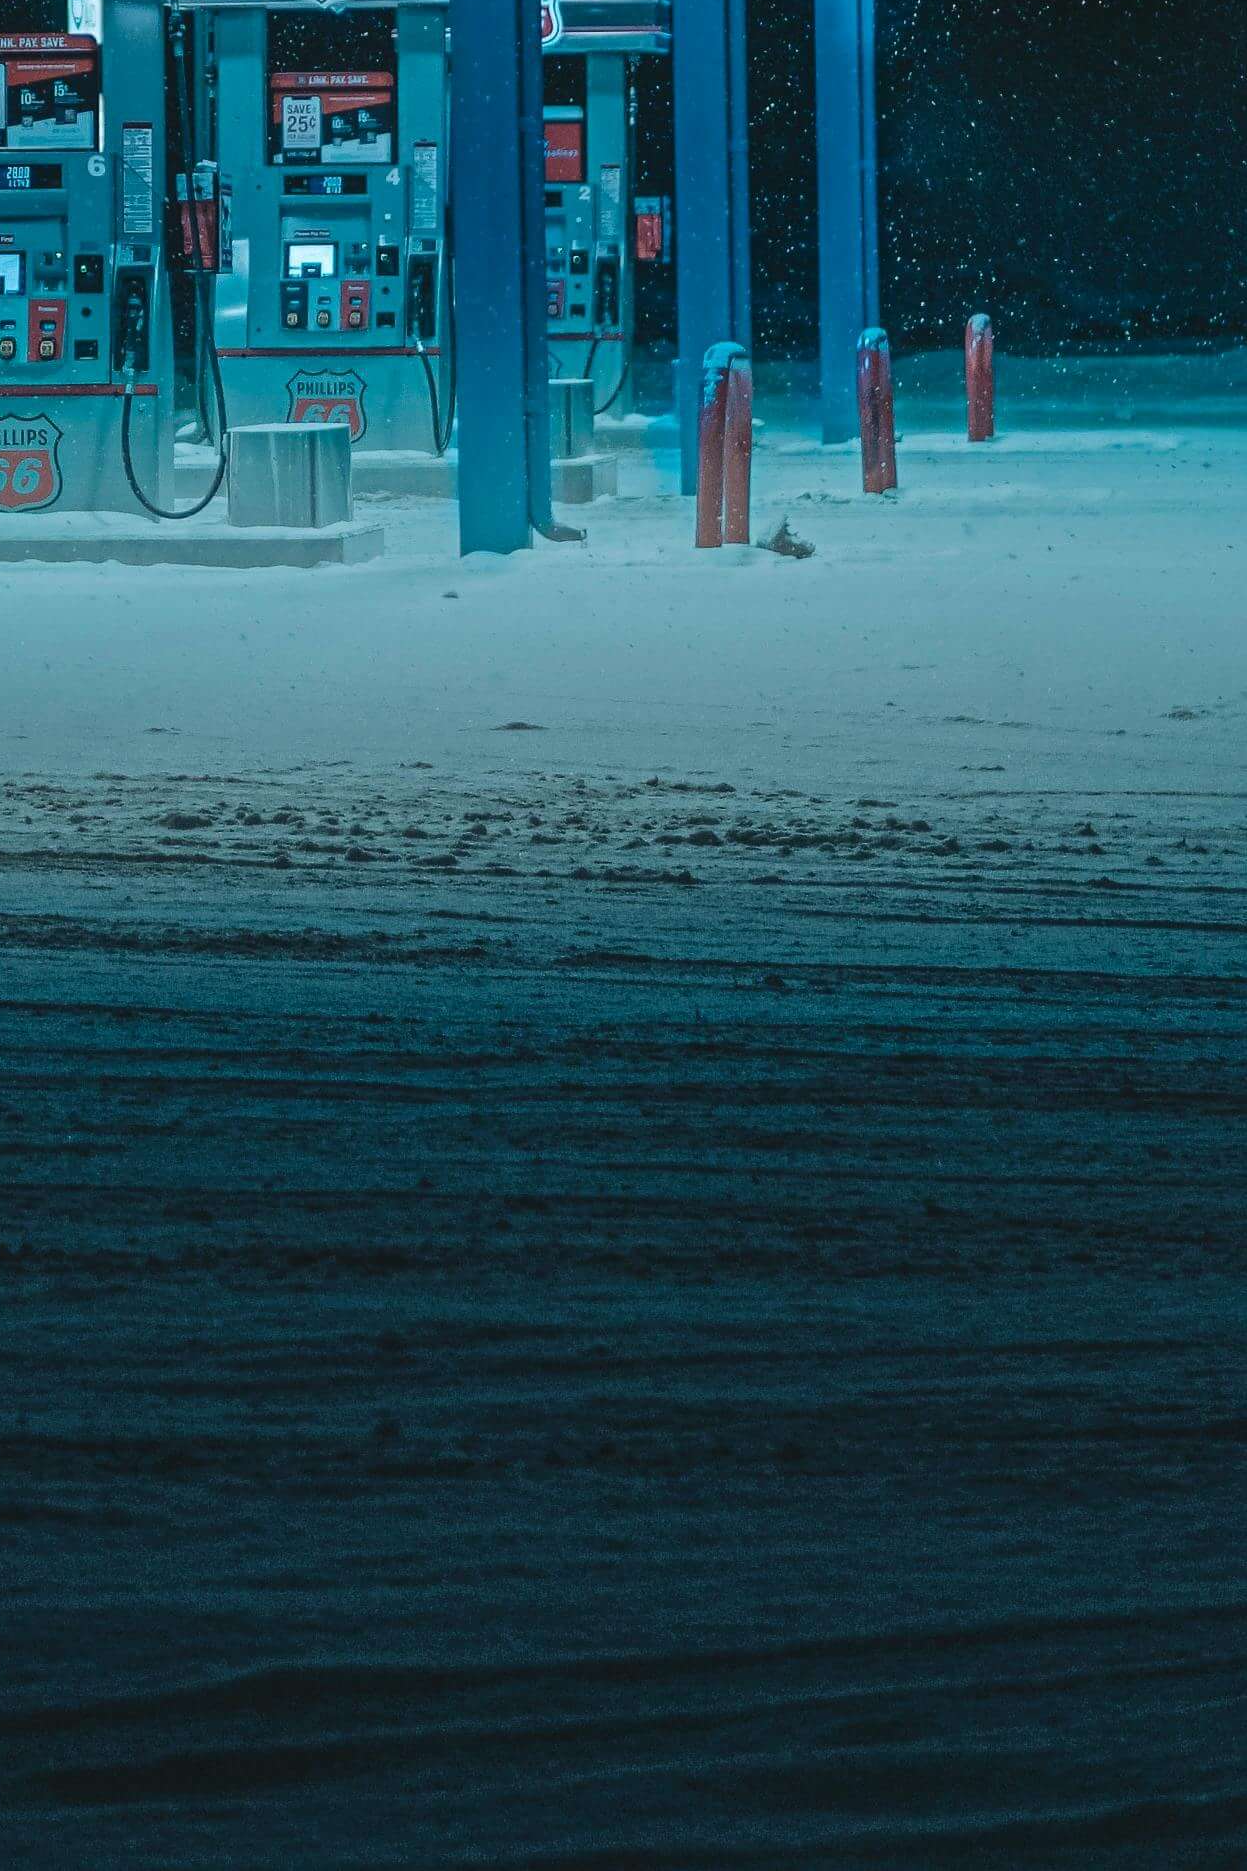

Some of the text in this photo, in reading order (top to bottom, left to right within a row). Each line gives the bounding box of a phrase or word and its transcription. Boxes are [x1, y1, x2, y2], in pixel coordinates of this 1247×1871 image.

[287, 104, 312, 115] SAVE
[287, 115, 317, 133] 25¢
[87, 155, 106, 176] 6
[385, 167, 400, 185] 4
[579, 187, 591, 200] 2
[296, 381, 355, 395] PHILLIPS
